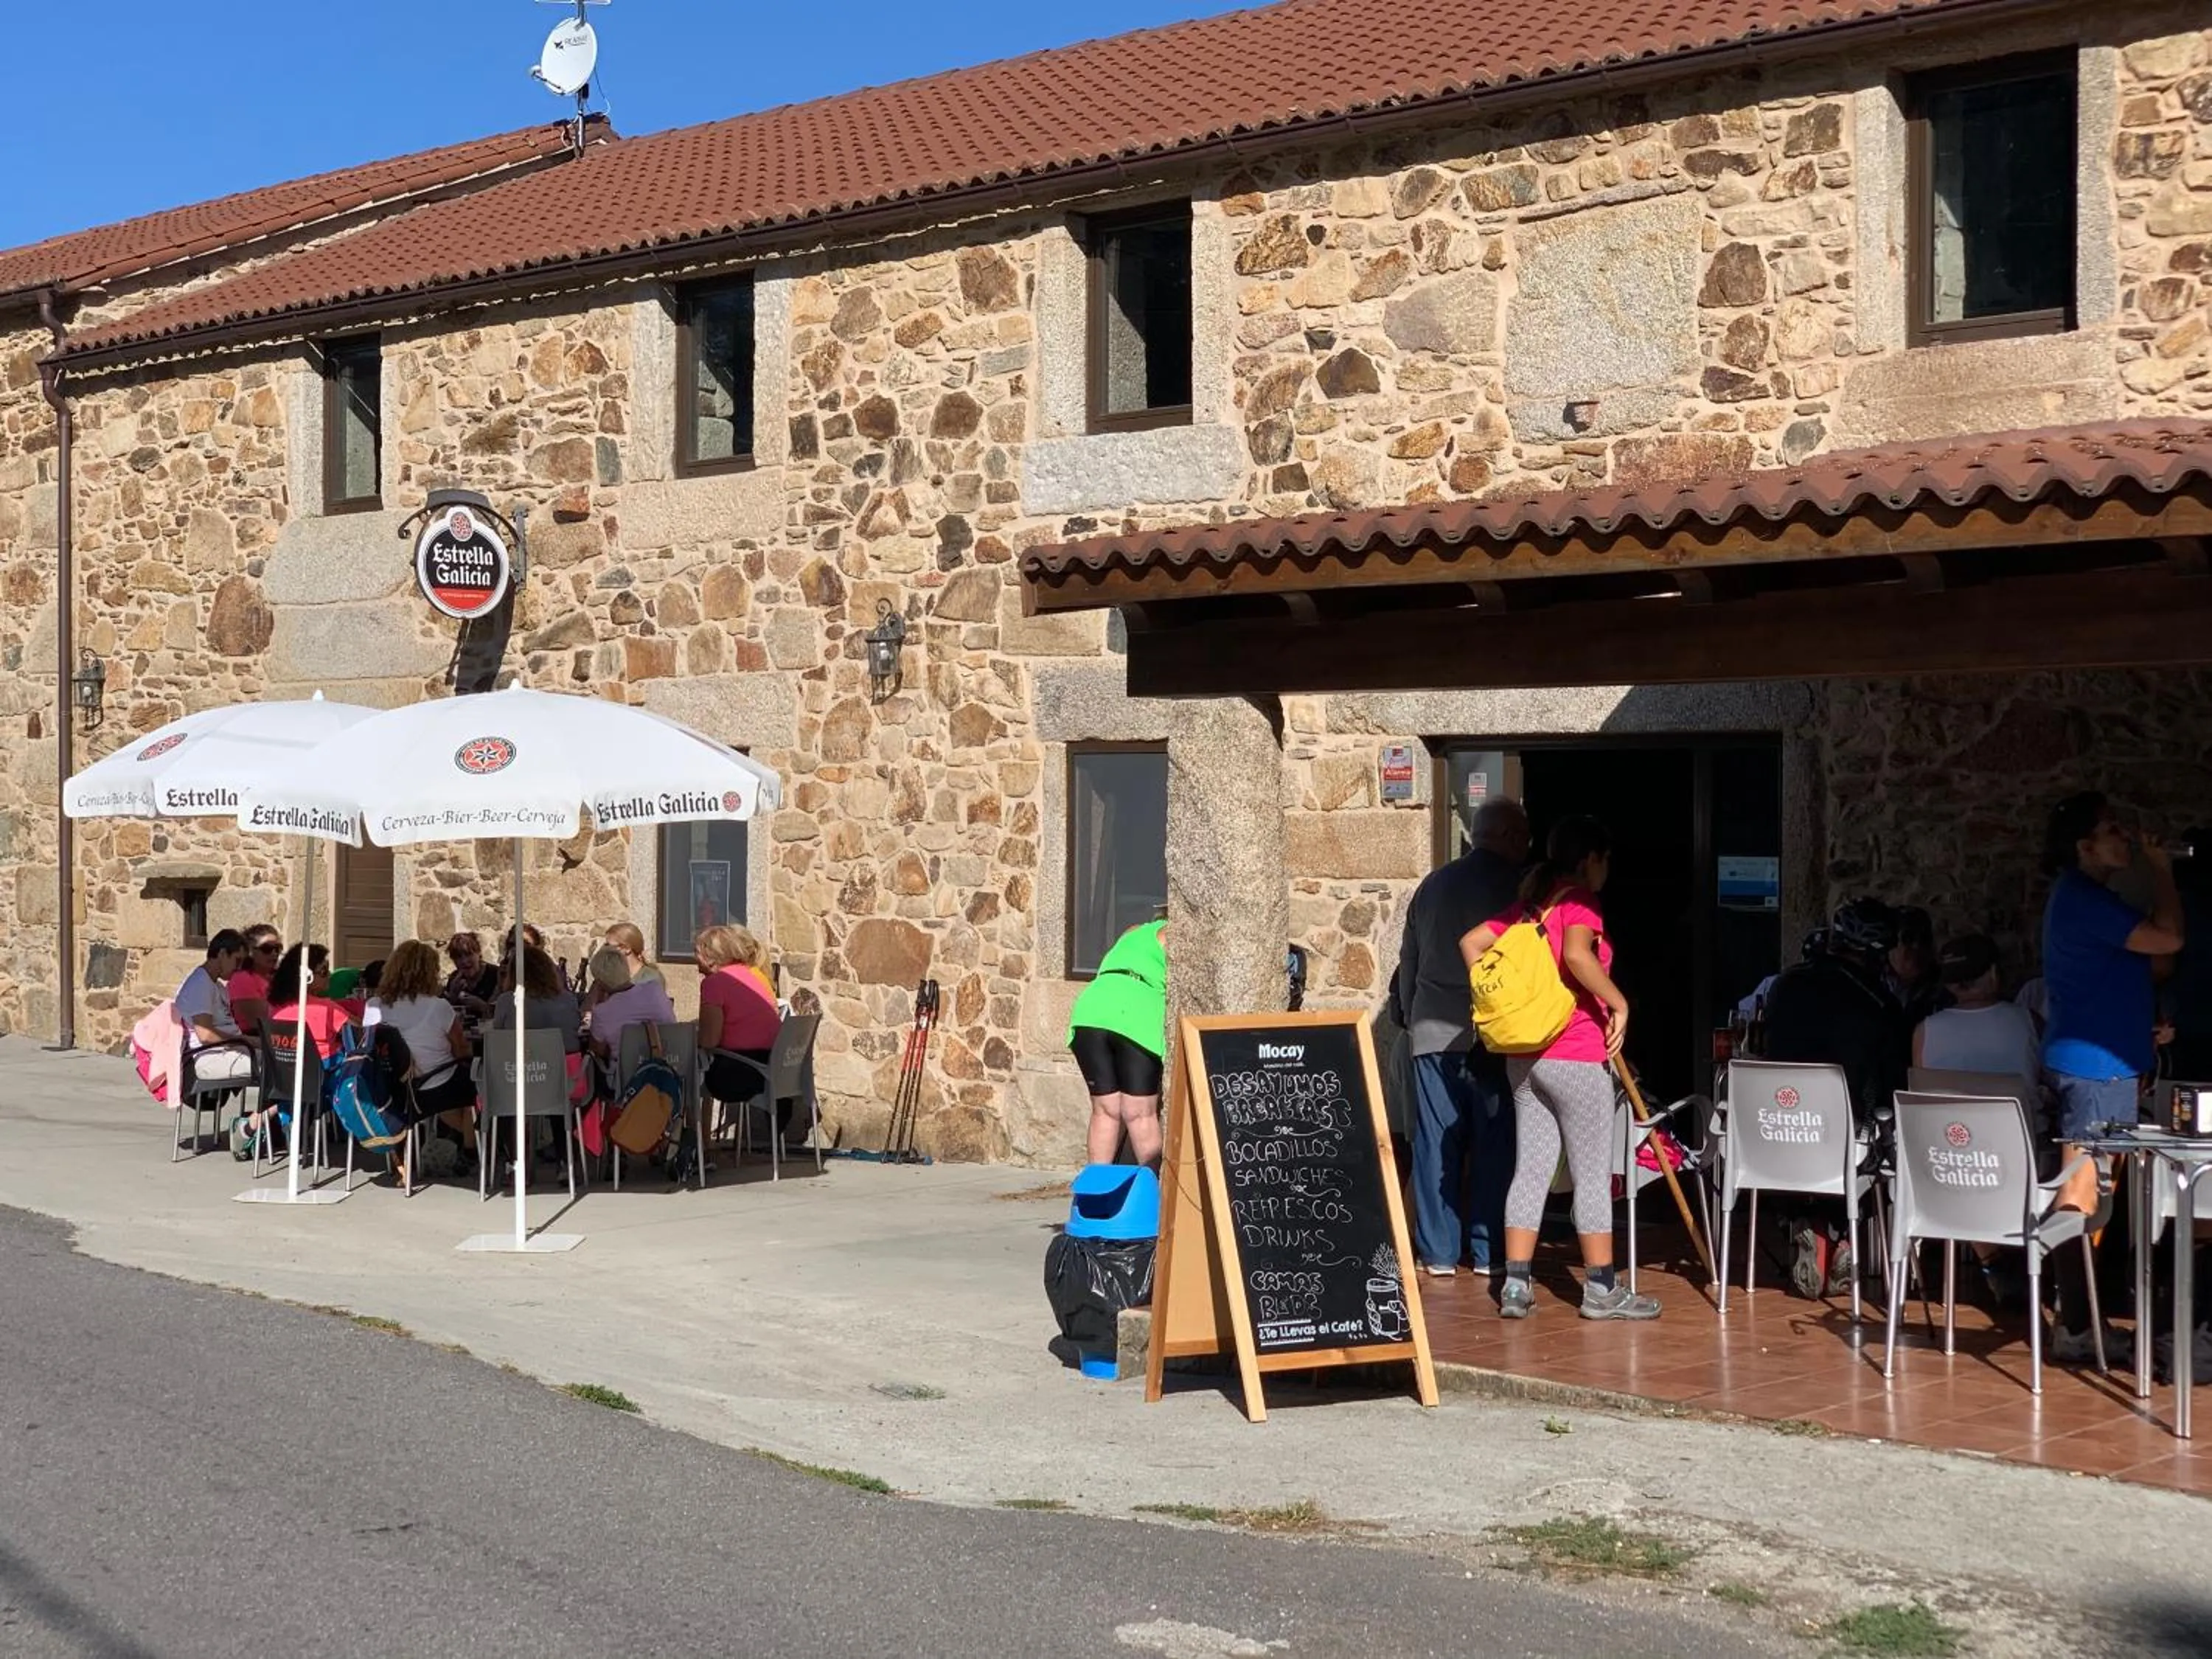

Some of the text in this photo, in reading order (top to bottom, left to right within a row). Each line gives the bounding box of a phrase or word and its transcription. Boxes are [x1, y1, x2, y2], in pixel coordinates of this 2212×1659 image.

[433, 543, 494, 566] Estrella
[436, 564, 491, 585] Galicia
[167, 788, 238, 807] Estrella
[597, 792, 719, 823] Estrella Galicia
[249, 804, 307, 827] Estrella
[1259, 1043, 1304, 1061] Mocay
[1209, 1071, 1341, 1099] DESAYUNOS
[1222, 1094, 1352, 1128] BREAKFAST
[1758, 1108, 1822, 1127] Estrella
[1760, 1124, 1820, 1142] Galicia
[1225, 1138, 1338, 1164] BOCADILLOS
[1928, 1145, 1999, 1168] Estrella
[1235, 1166, 1353, 1186] SANDWICHES
[1933, 1165, 1999, 1186] Galicia
[1231, 1197, 1353, 1225] REFRESCOS
[1243, 1225, 1335, 1251] DRINKS
[1250, 1270, 1325, 1294] CAMAS
[1259, 1293, 1322, 1321] BEDS
[1259, 1327, 1277, 1340] ¿Te
[1318, 1321, 1329, 1334] el
[1331, 1319, 1363, 1333] Café?
